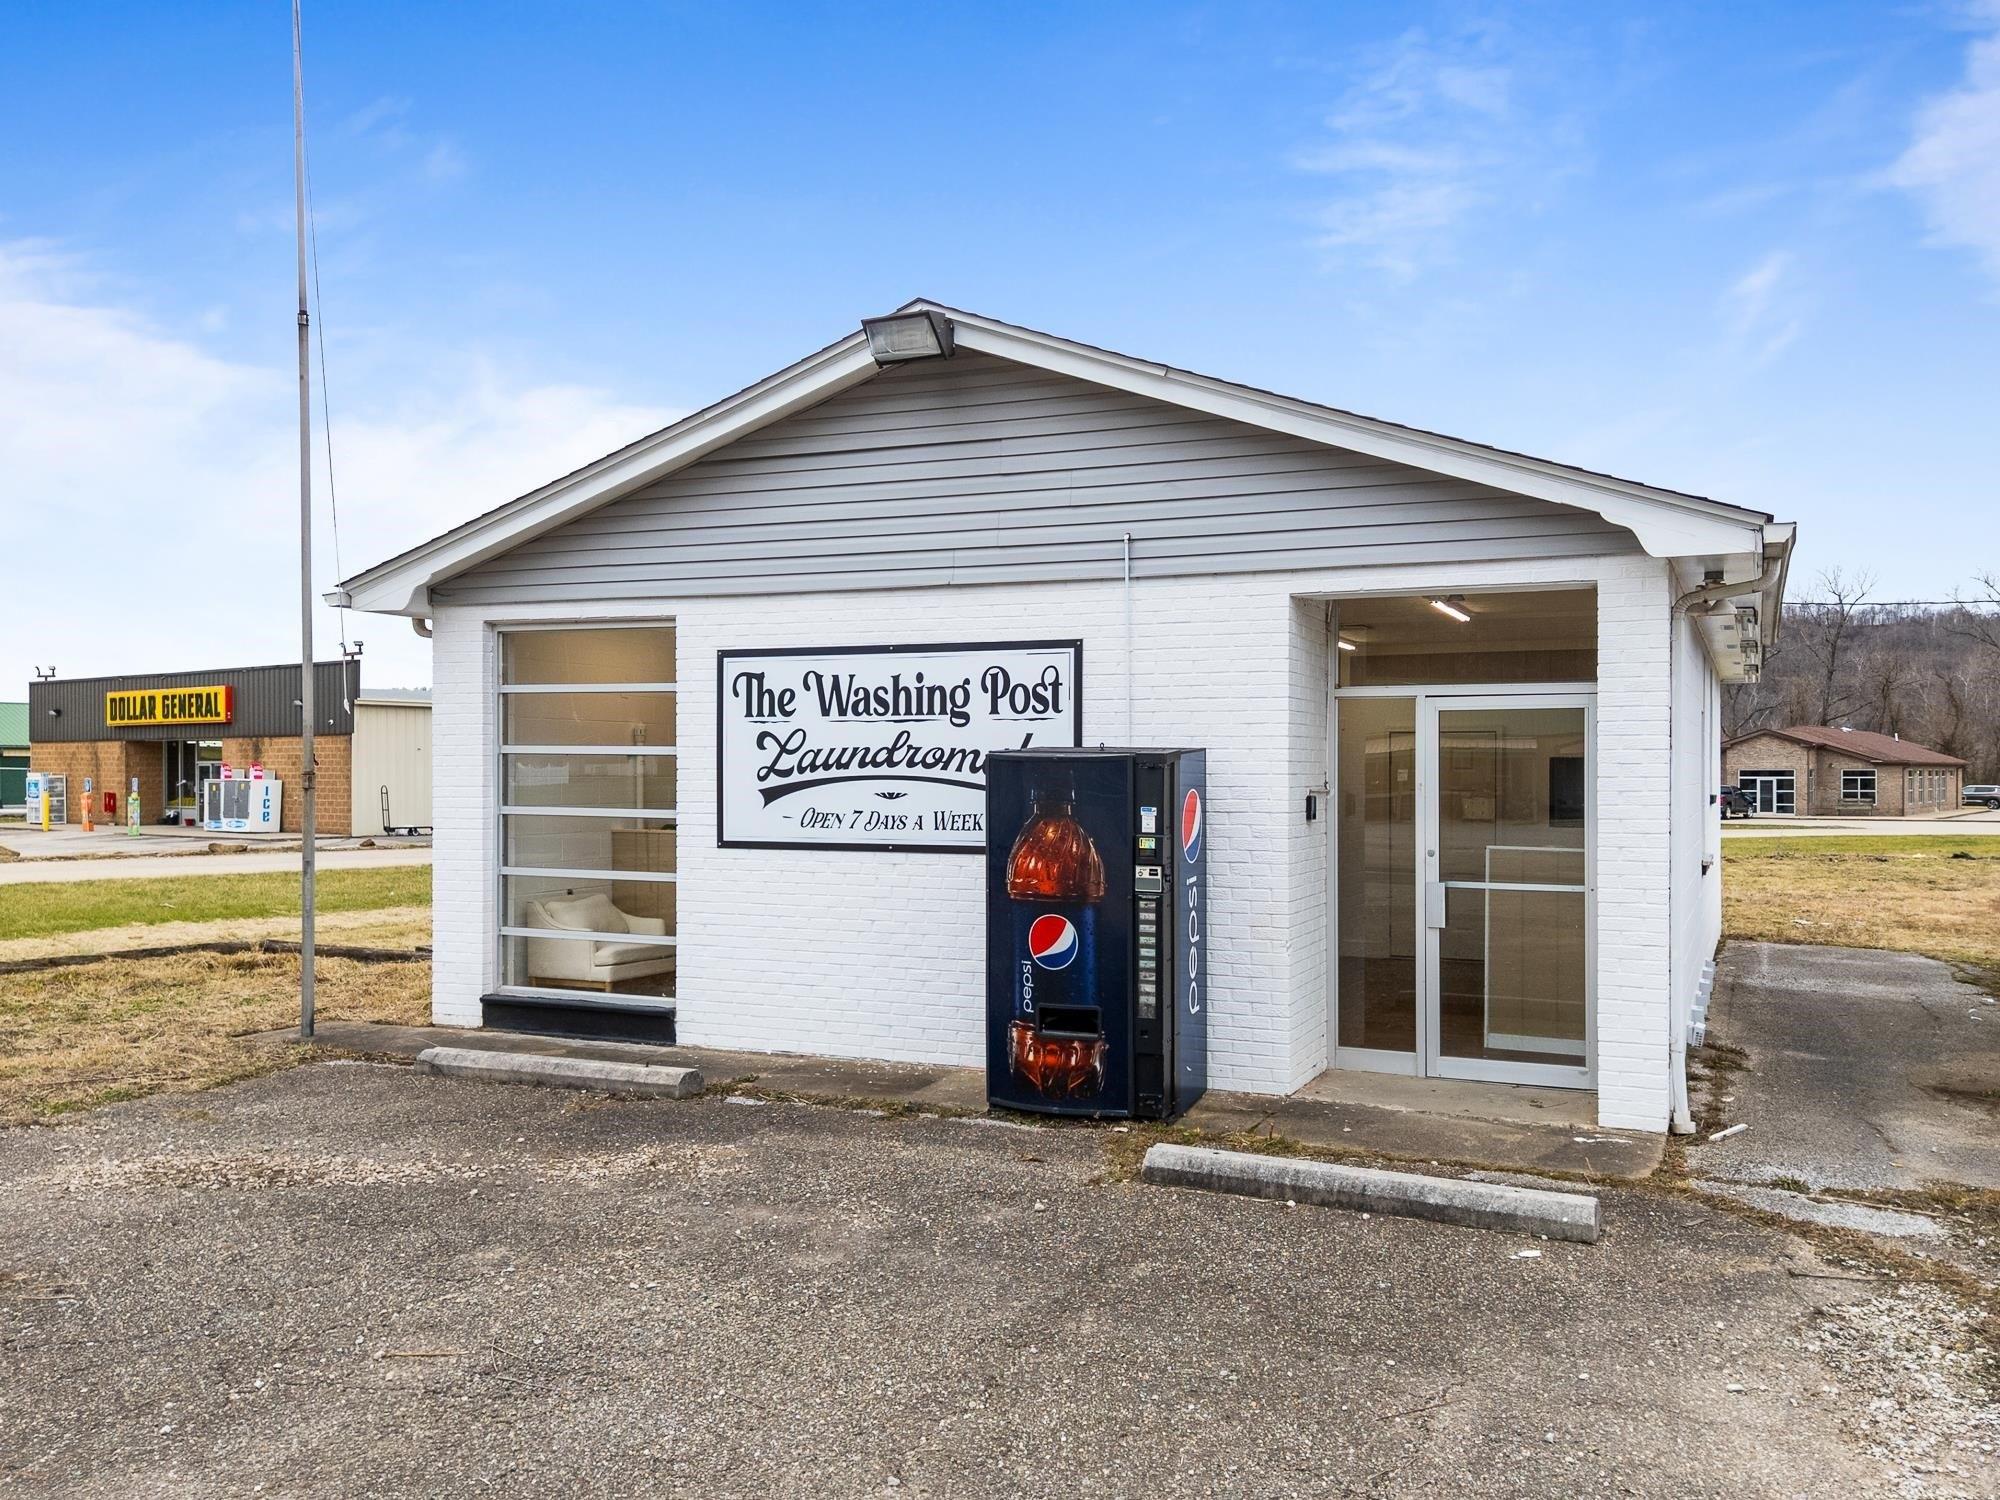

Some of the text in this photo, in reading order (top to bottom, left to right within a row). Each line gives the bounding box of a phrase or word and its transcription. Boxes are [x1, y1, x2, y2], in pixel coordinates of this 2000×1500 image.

[109, 692, 221, 721] DOLLAR GENERAL
[732, 665, 1063, 728] The Washing Post
[756, 729, 1034, 782] Laundrom
[848, 809, 864, 830] 7
[1185, 875, 1200, 1015] pepsi
[1022, 960, 1034, 1013] pepsi
